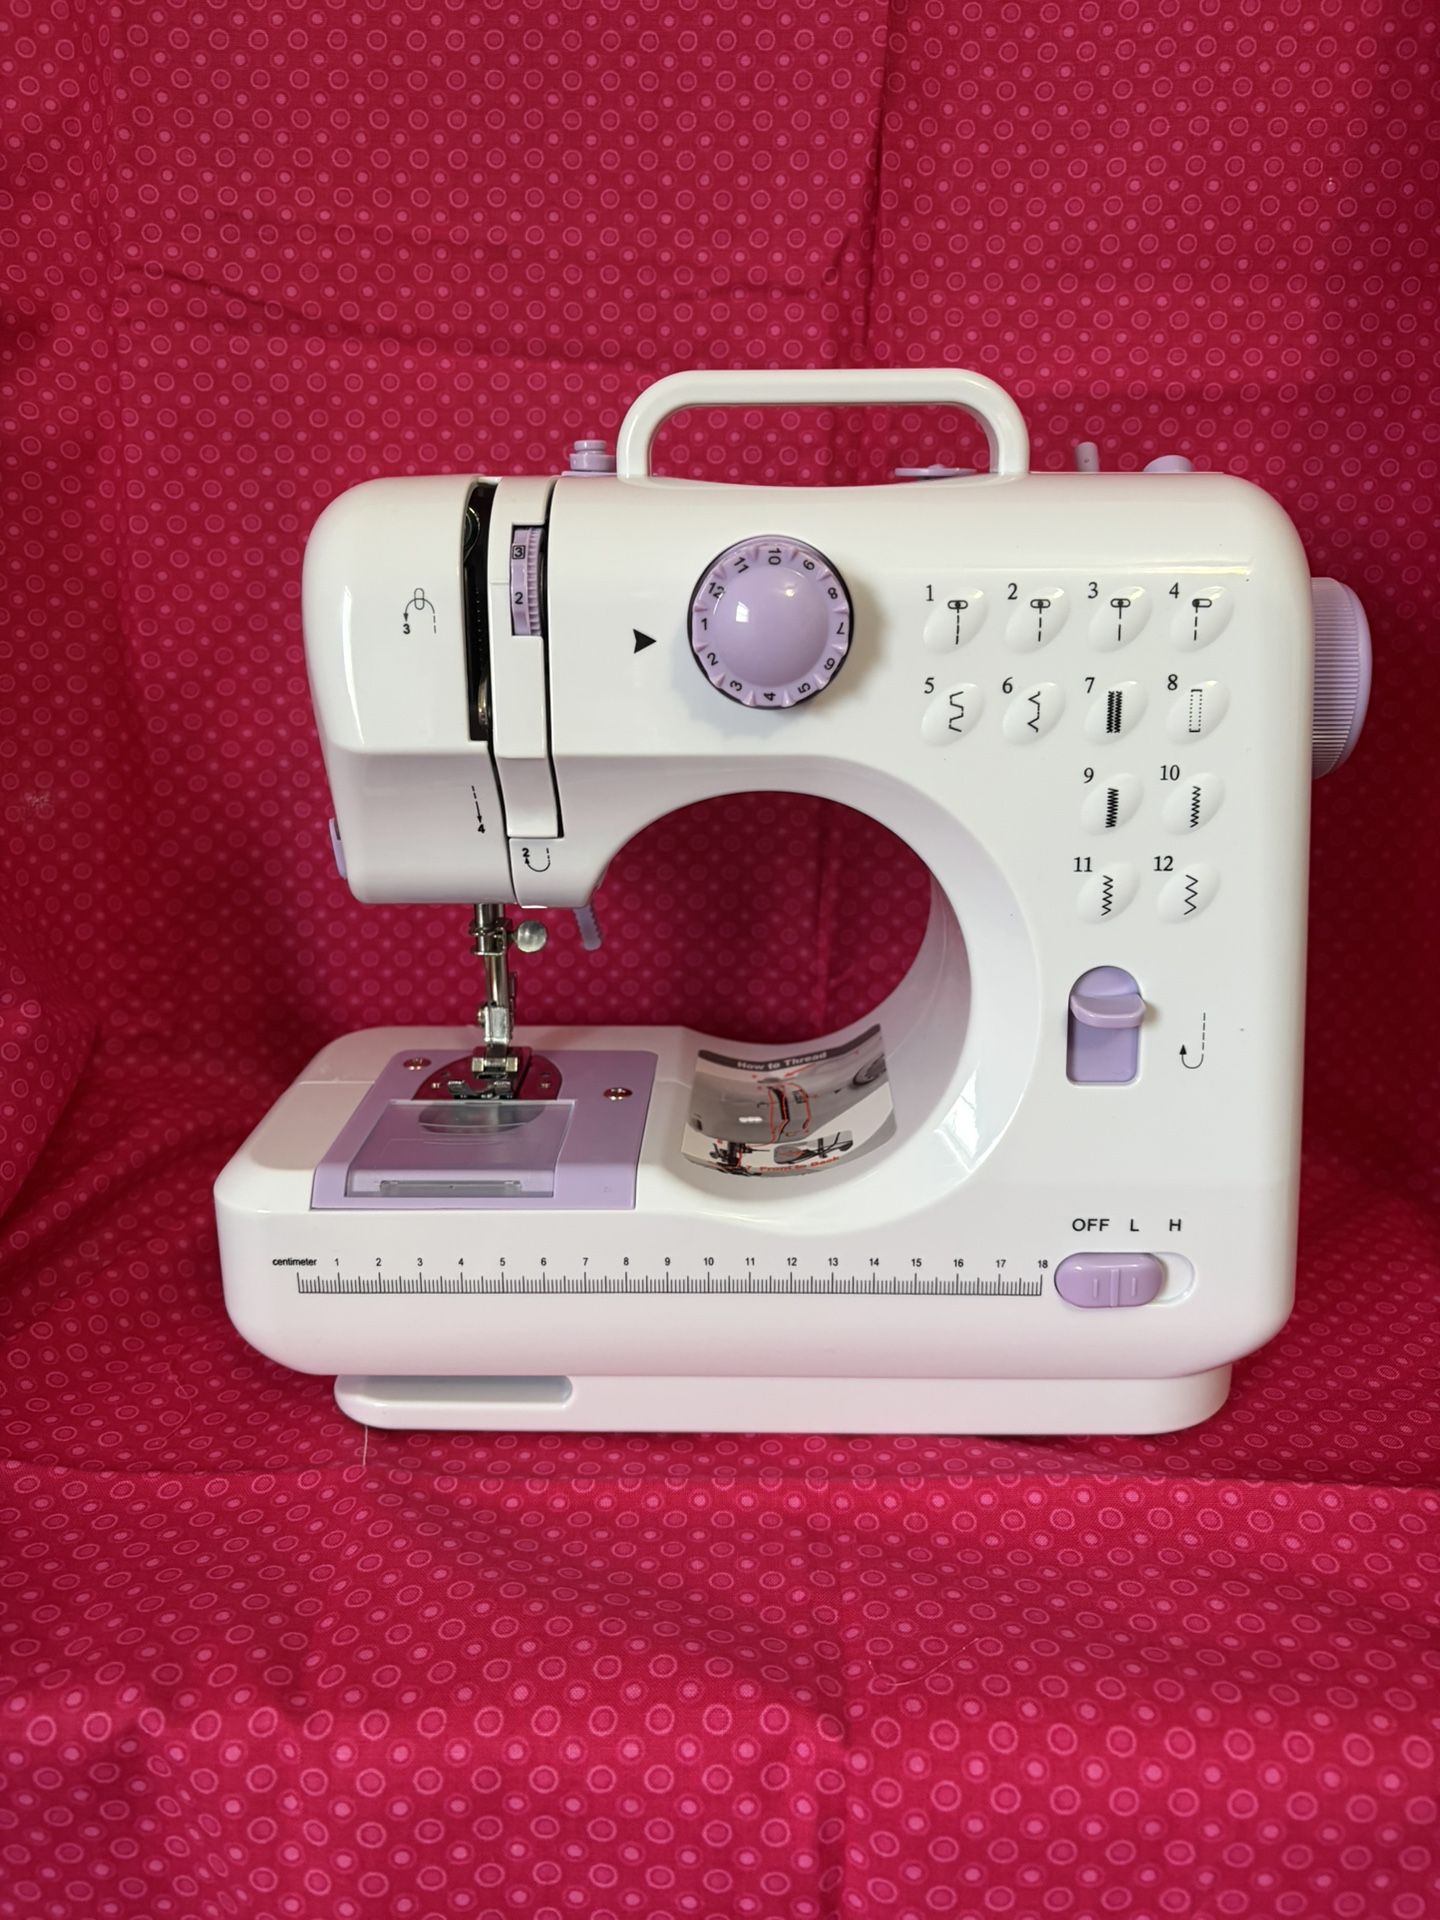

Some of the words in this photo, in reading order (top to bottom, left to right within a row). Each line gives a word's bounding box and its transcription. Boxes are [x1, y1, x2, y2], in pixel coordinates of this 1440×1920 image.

[514, 547, 523, 557] 3
[767, 547, 782, 566] 10
[733, 556, 750, 574] 11
[708, 581, 726, 600] 12
[827, 586, 839, 600] 8
[926, 584, 934, 602] 1
[1007, 582, 1018, 601] 2
[1087, 581, 1099, 600] 3
[1168, 582, 1180, 599] 4
[514, 591, 524, 606] 2
[402, 623, 411, 635] 3
[700, 617, 708, 631] 1
[836, 621, 845, 635] 7
[706, 652, 719, 667] 2
[823, 657, 836, 671] 6
[729, 680, 743, 692] 3
[797, 682, 811, 694] 5
[924, 677, 935, 695] 5
[1001, 676, 1013, 695] 6
[1084, 676, 1095, 694] 7
[1167, 673, 1178, 691] 8
[763, 692, 776, 702] 4
[1083, 767, 1095, 784] 9
[1160, 764, 1181, 781] 10
[476, 822, 486, 835] 4
[521, 847, 530, 859] 2
[1073, 856, 1093, 873] 11
[1153, 855, 1174, 872] 12
[737, 1061, 765, 1070] How
[767, 1062, 780, 1070] to
[783, 1051, 828, 1067] Thread
[1071, 1218, 1110, 1232] OFF
[1129, 1218, 1140, 1232] L
[1168, 1218, 1182, 1232] H
[271, 1257, 317, 1267] centimeter
[334, 1257, 340, 1267] 1
[375, 1257, 382, 1267] 2
[417, 1257, 424, 1267] 3
[458, 1257, 464, 1266] 4
[499, 1257, 506, 1267] 5
[540, 1257, 547, 1267] 6
[582, 1257, 589, 1266] 7
[623, 1256, 630, 1267] 8
[664, 1256, 671, 1267] 9
[703, 1256, 715, 1267] 10
[745, 1257, 755, 1266] 11
[786, 1256, 798, 1267] 12
[828, 1257, 839, 1267] 13
[869, 1257, 880, 1267] 14
[911, 1257, 922, 1268] 15
[953, 1258, 964, 1268] 16
[995, 1258, 1007, 1269] 17
[1037, 1259, 1049, 1269] 18
